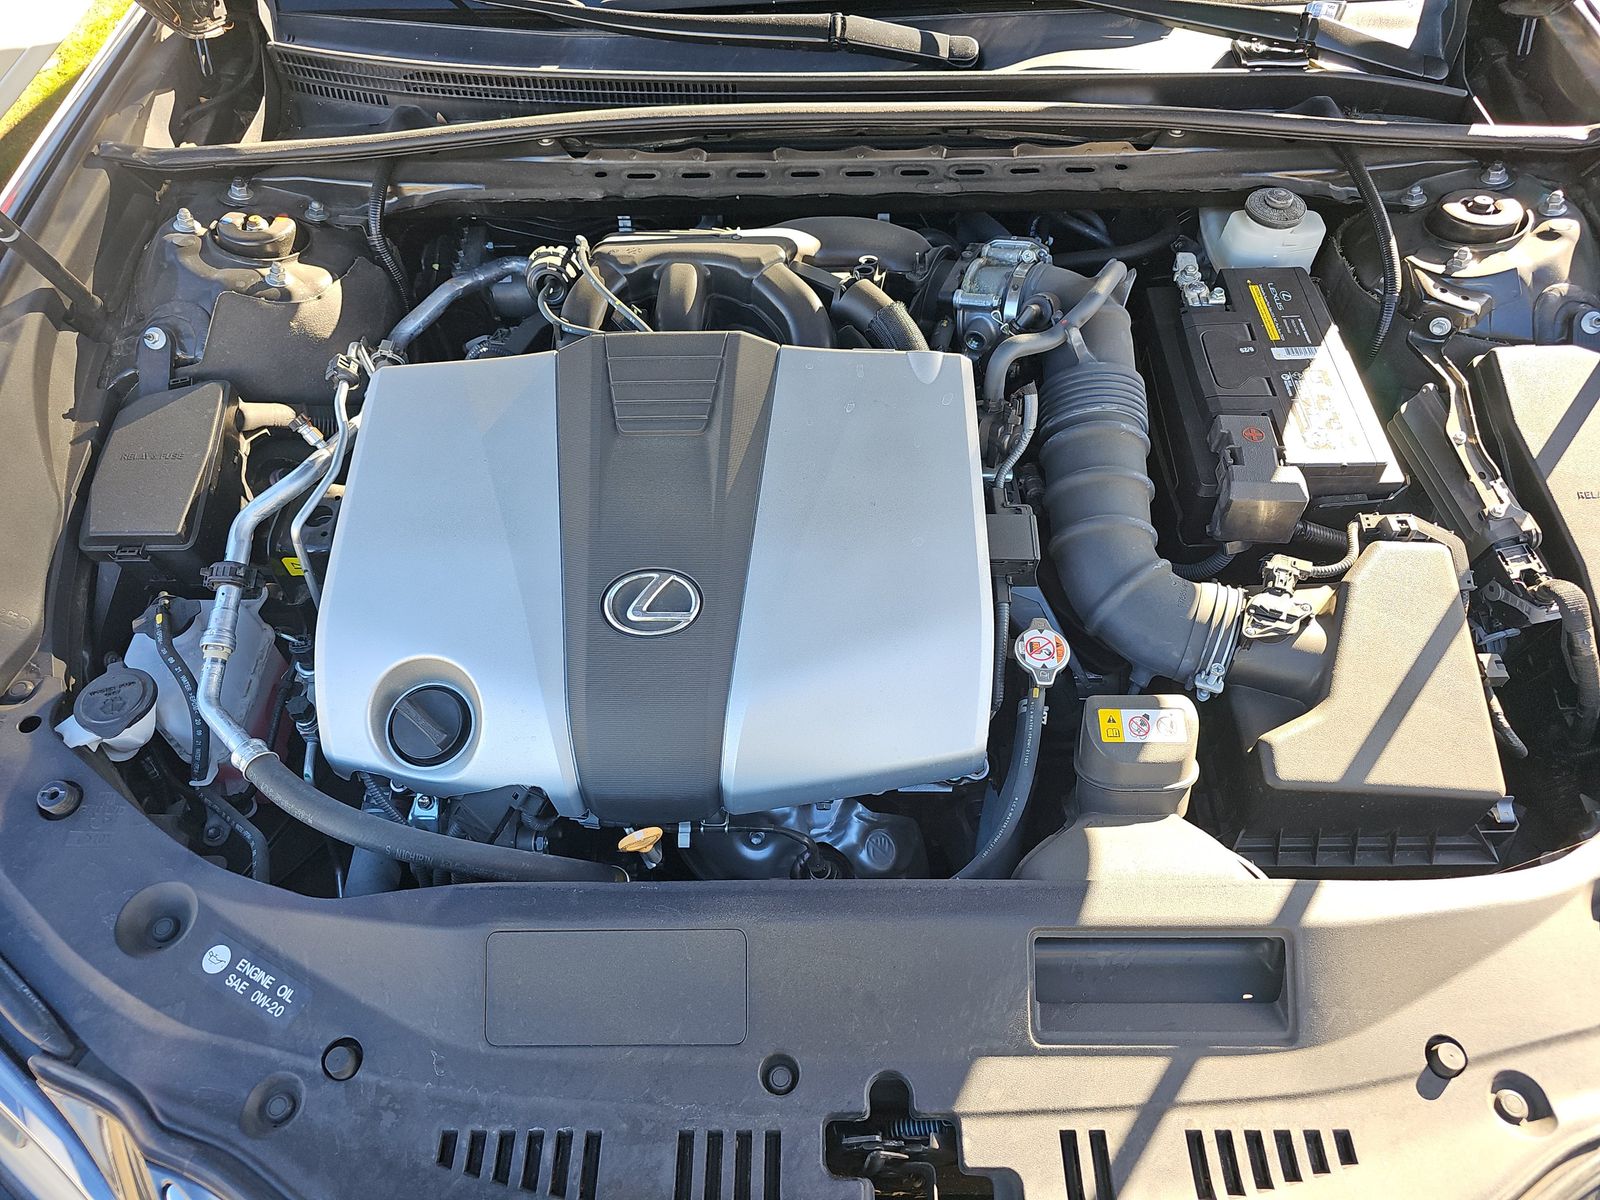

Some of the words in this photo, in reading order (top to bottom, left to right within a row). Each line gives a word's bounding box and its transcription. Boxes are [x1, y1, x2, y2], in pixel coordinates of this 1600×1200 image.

[1267, 282, 1285, 311] LEXUS
[159, 452, 184, 461] FUSE
[180, 674, 192, 692] WATER
[194, 718, 202, 726] 20
[224, 973, 250, 995] SAE
[250, 990, 285, 1018] 0W-20
[235, 958, 276, 990] ENGINE
[276, 984, 295, 1004] OIL
